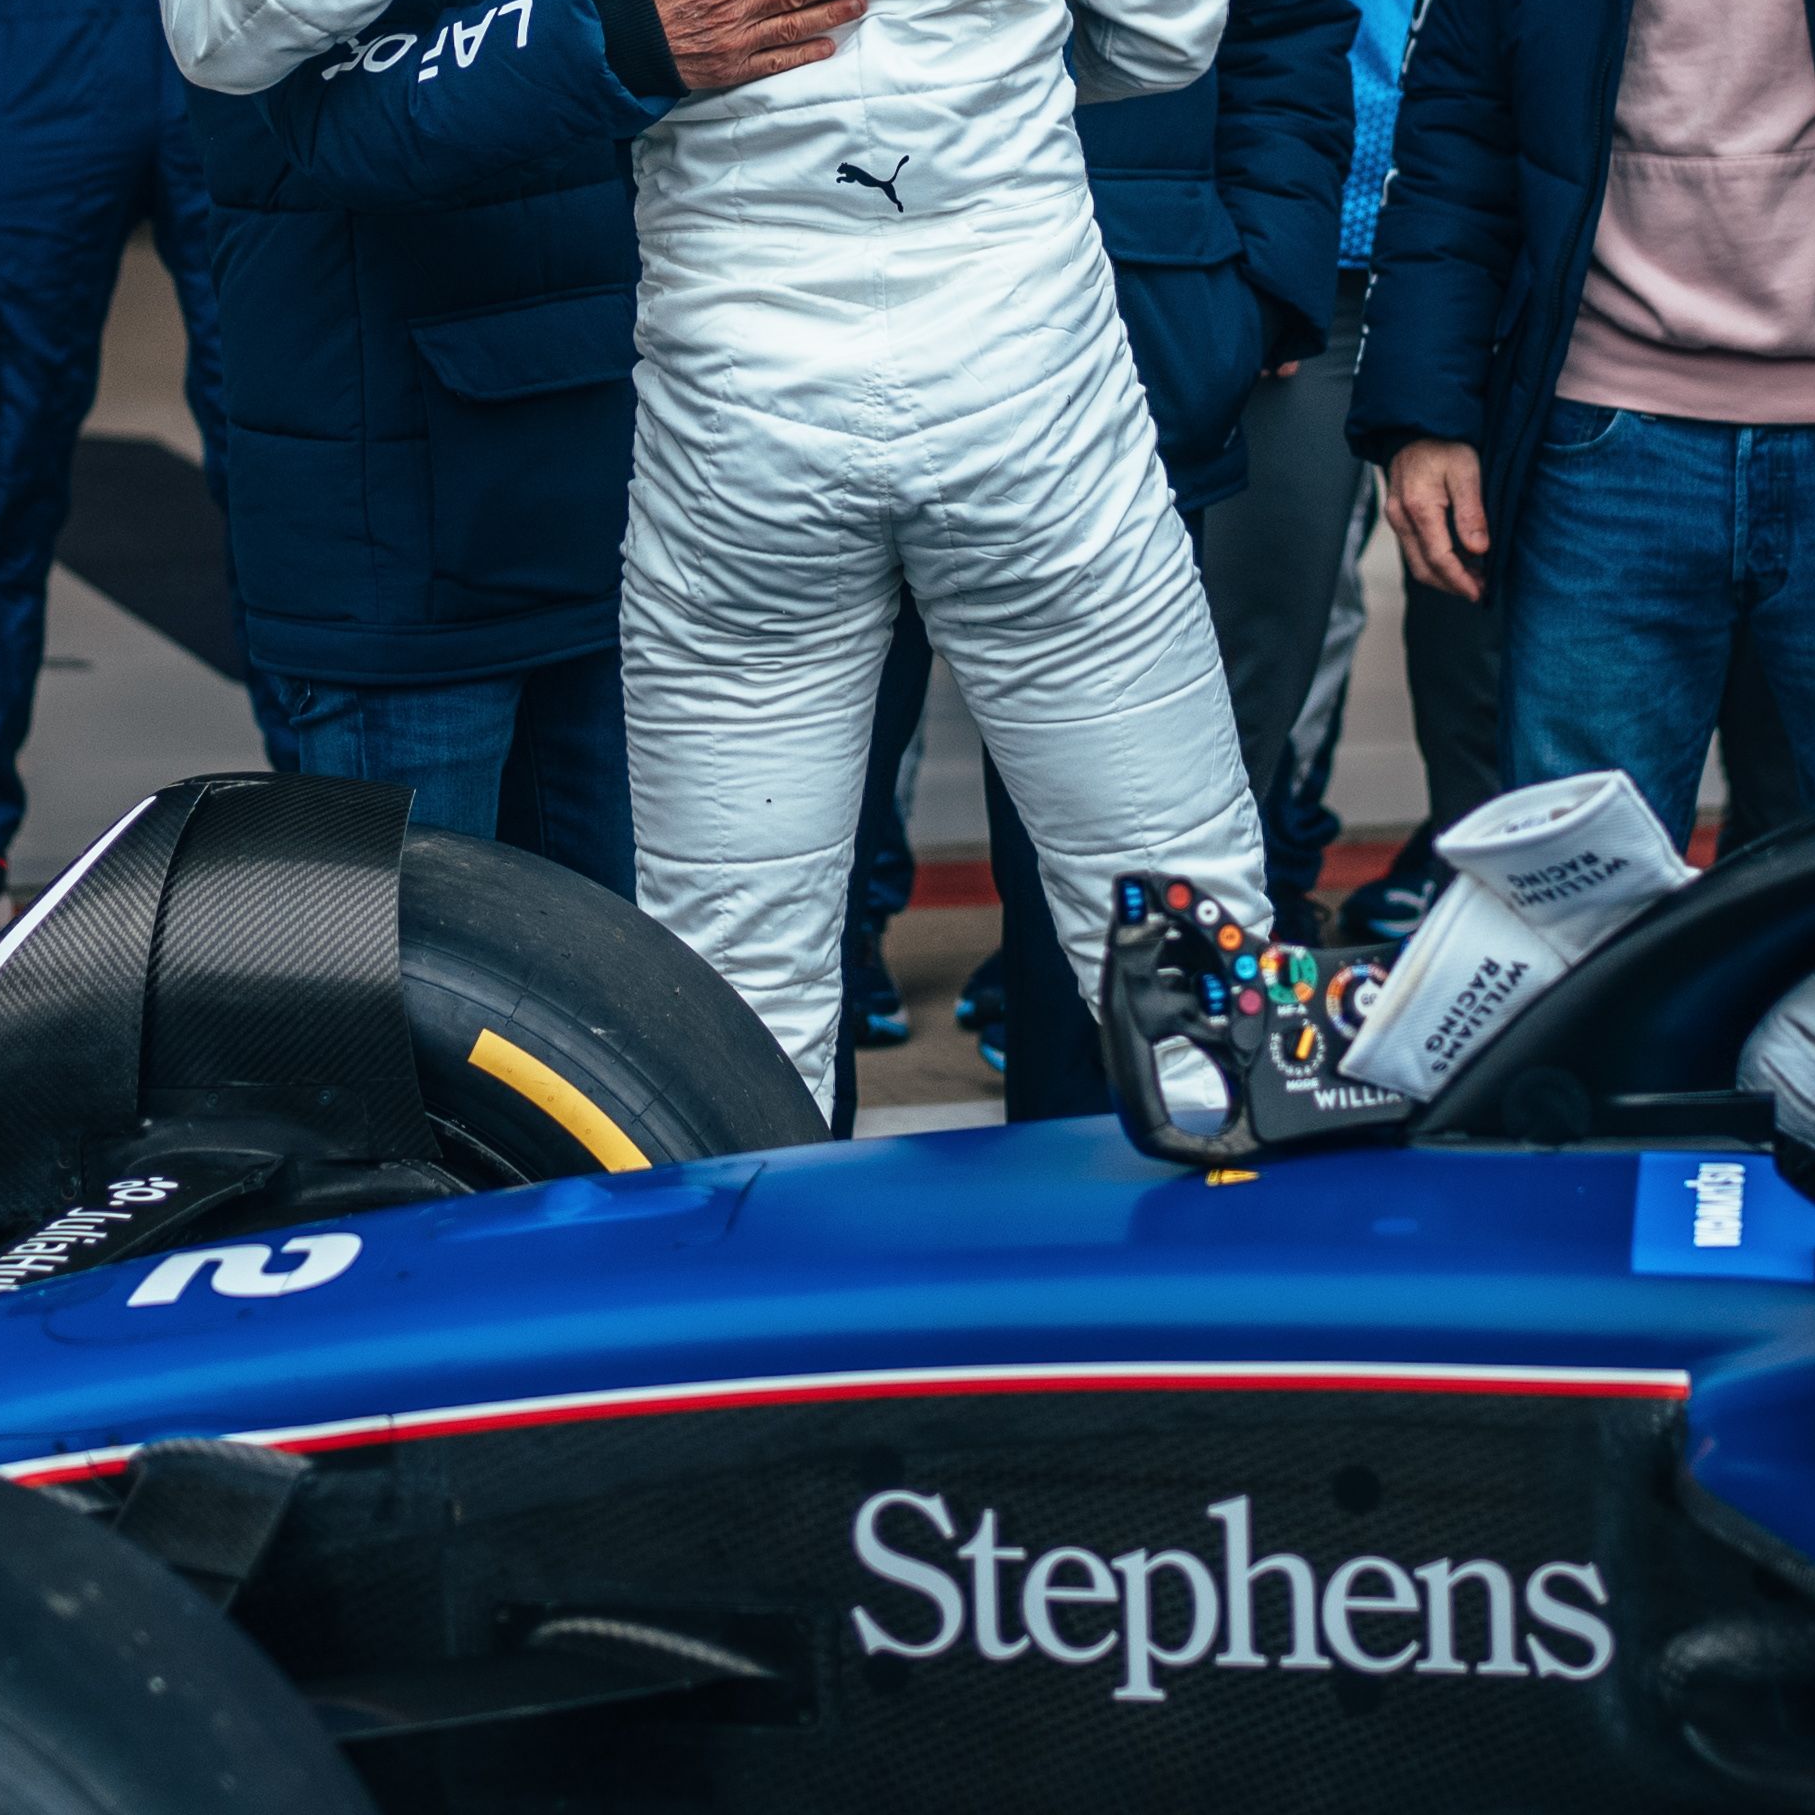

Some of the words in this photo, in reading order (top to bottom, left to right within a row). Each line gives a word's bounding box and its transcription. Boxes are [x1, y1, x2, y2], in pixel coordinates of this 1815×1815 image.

[1507, 851, 1601, 889] RACING
[1425, 955, 1501, 1053] RACING
[1431, 959, 1531, 1074] WILLIAMS
[126, 1232, 363, 1307] 2
[850, 1489, 1616, 1701] Stephens
